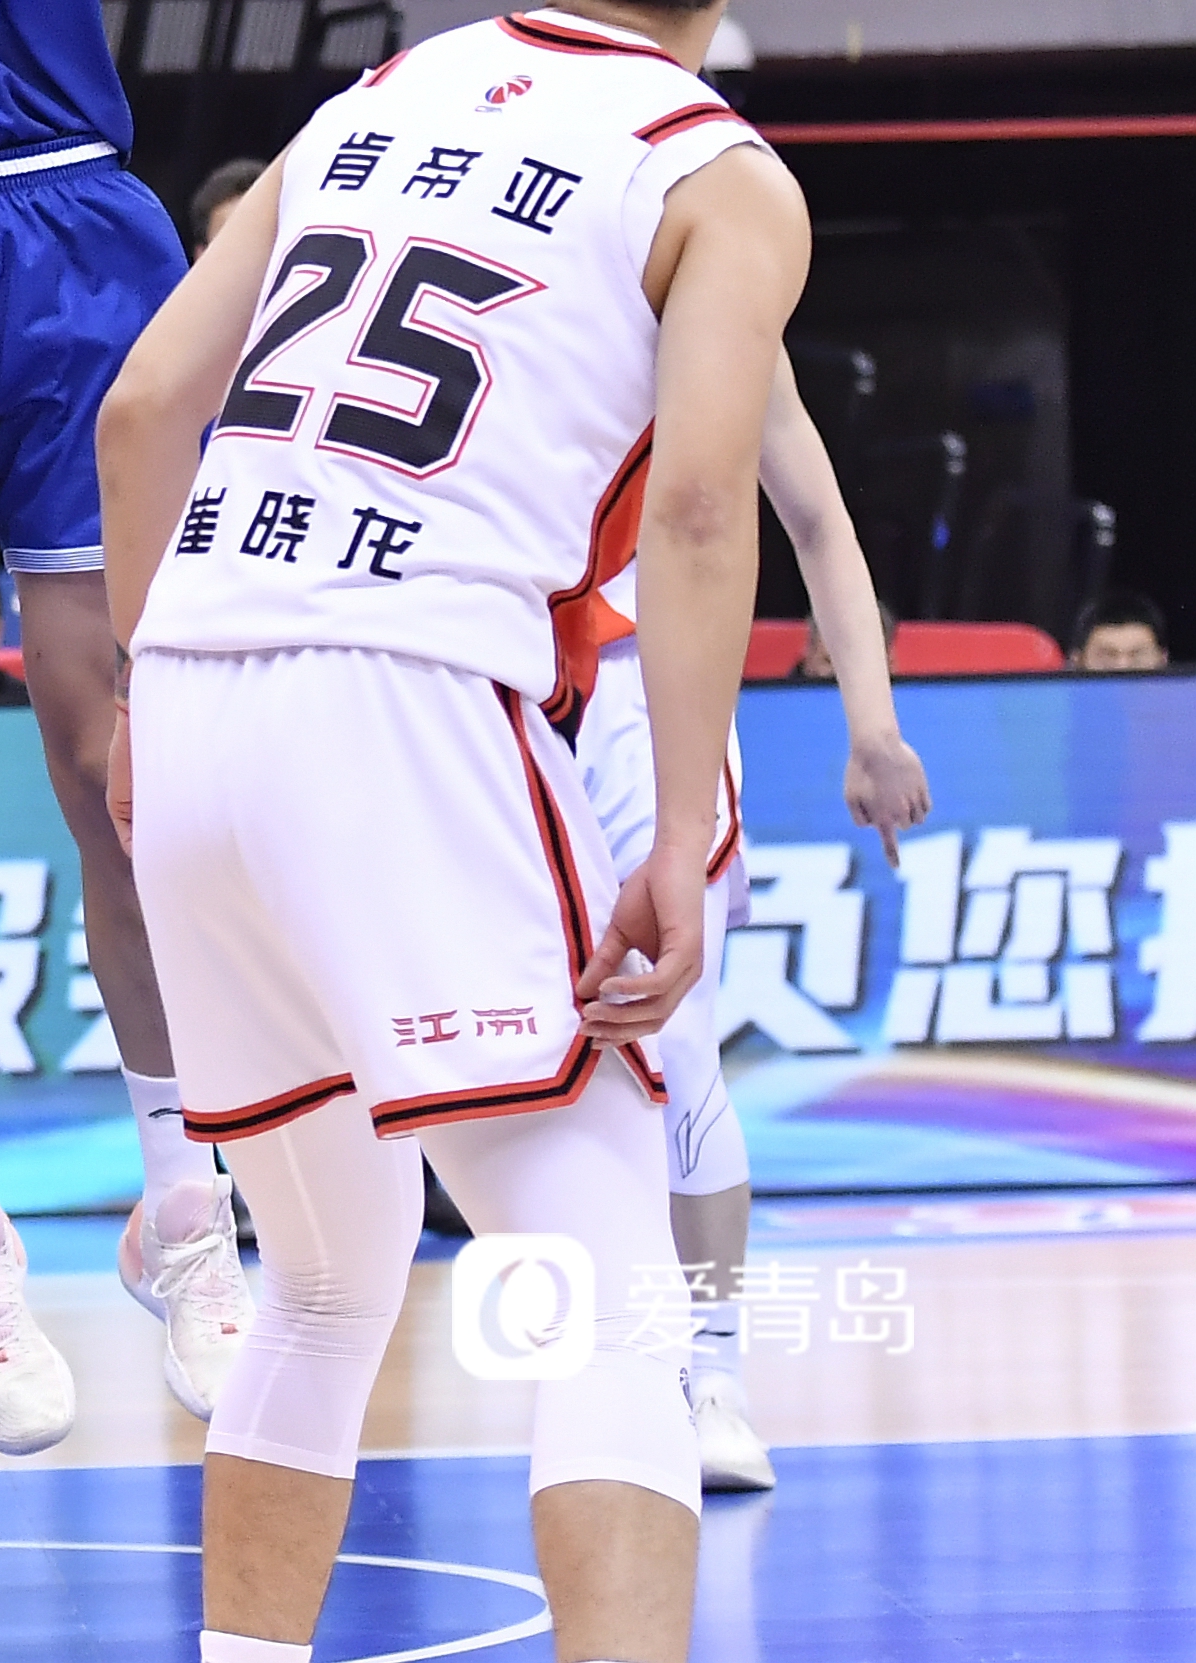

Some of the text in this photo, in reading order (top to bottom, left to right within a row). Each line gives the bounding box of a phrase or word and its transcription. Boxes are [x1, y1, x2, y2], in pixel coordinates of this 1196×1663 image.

[320, 131, 584, 234] 肯帝亚
[211, 225, 549, 482] 25
[175, 487, 423, 580] 崔晓龙
